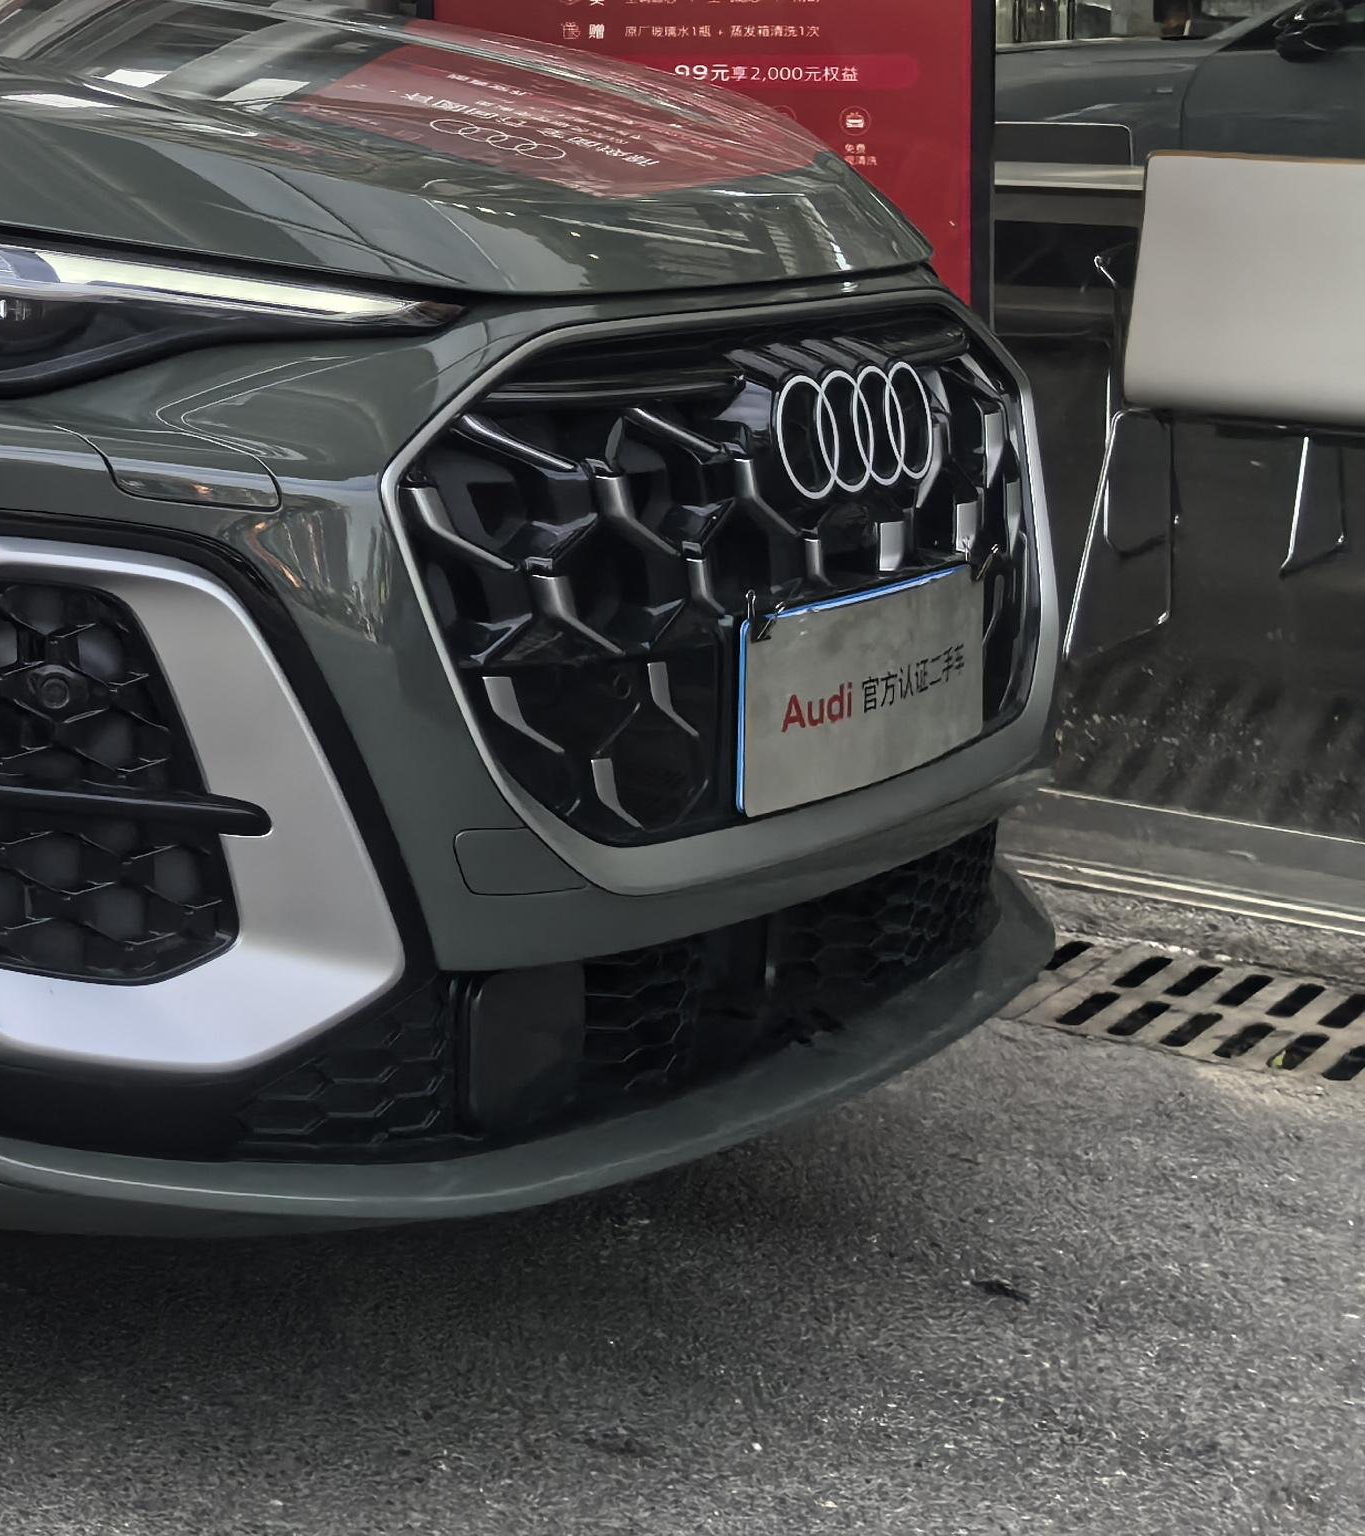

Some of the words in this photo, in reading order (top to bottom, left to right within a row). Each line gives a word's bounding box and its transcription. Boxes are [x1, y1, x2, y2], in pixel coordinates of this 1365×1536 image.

[589, 23, 605, 40] 赠
[781, 681, 853, 733] Audi
[862, 643, 965, 714] 官方认证二手车
